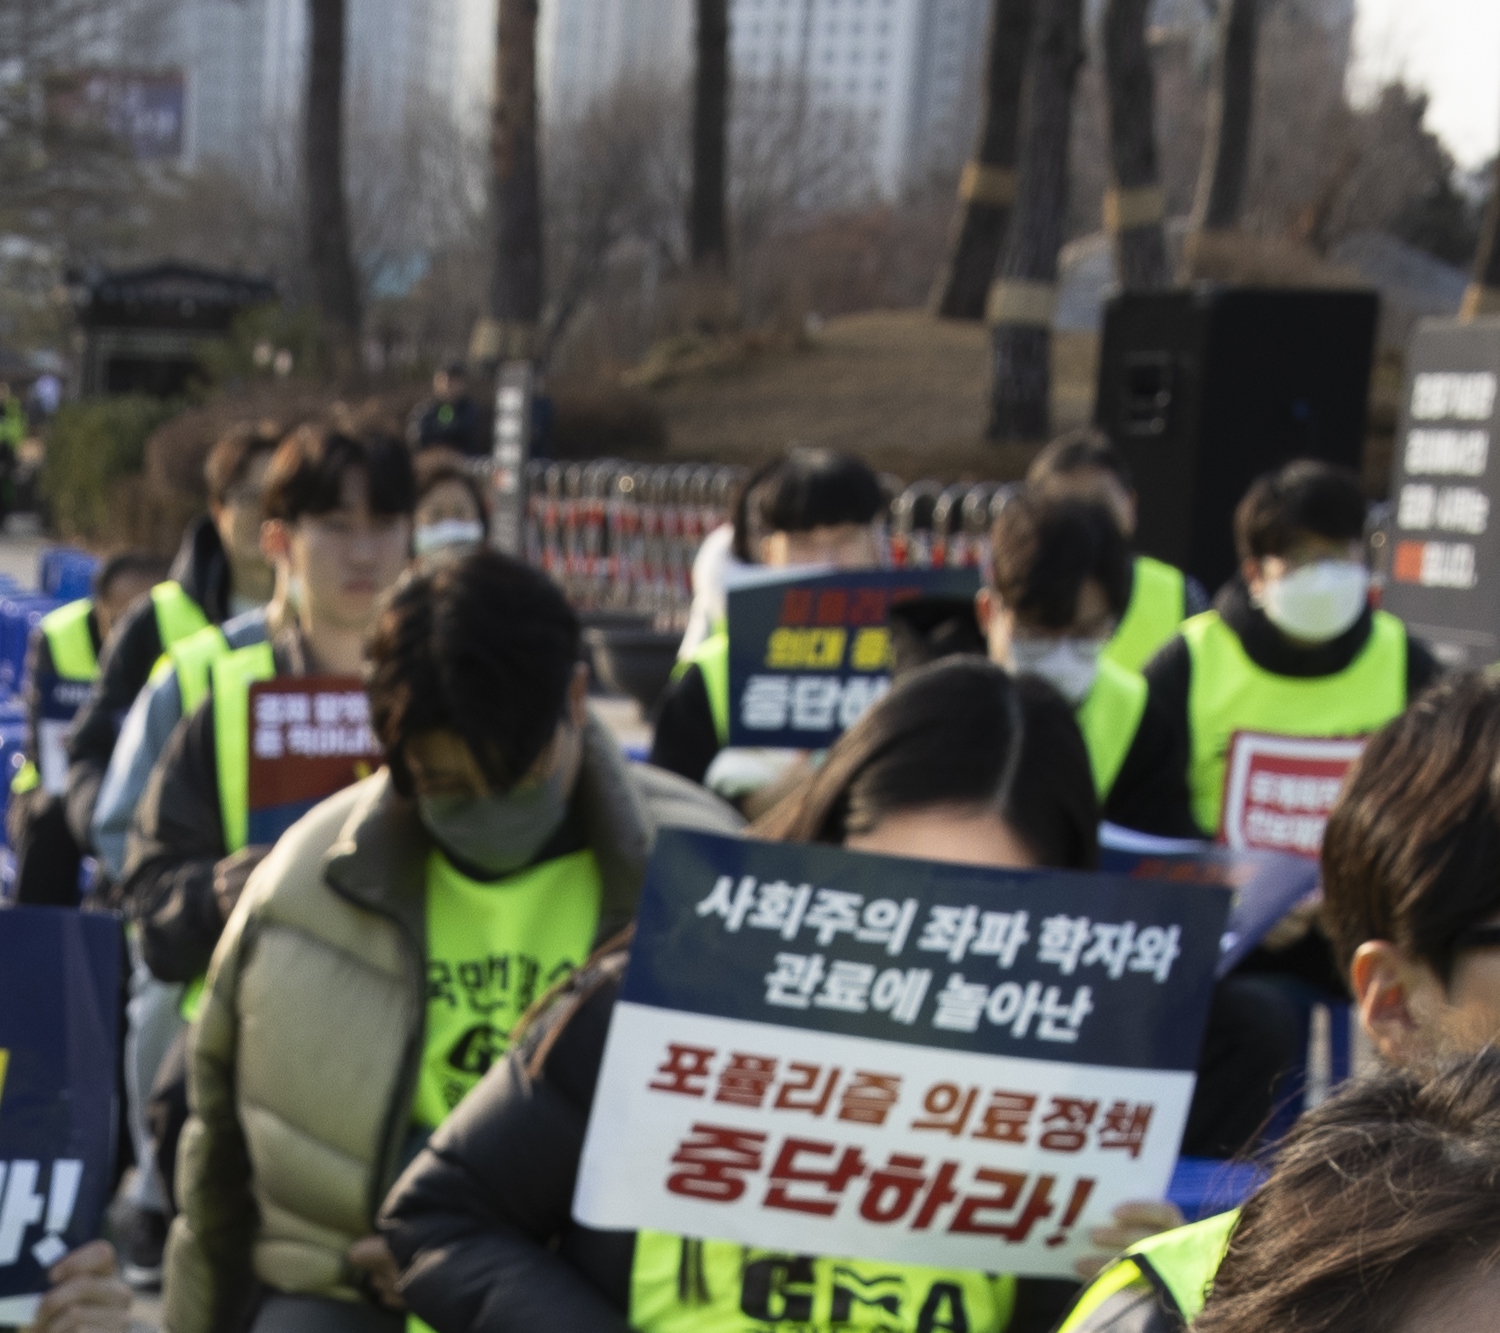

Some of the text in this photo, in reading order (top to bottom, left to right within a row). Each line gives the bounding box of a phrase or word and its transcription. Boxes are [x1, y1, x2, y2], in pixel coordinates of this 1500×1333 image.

[699, 875, 1181, 983] 사회주의 좌파 학자와
[764, 953, 1093, 1042] 관료에 놀아난
[649, 1042, 1155, 1159] 포퓰리즘 의료정책
[666, 1123, 1096, 1246] 중단하라!
